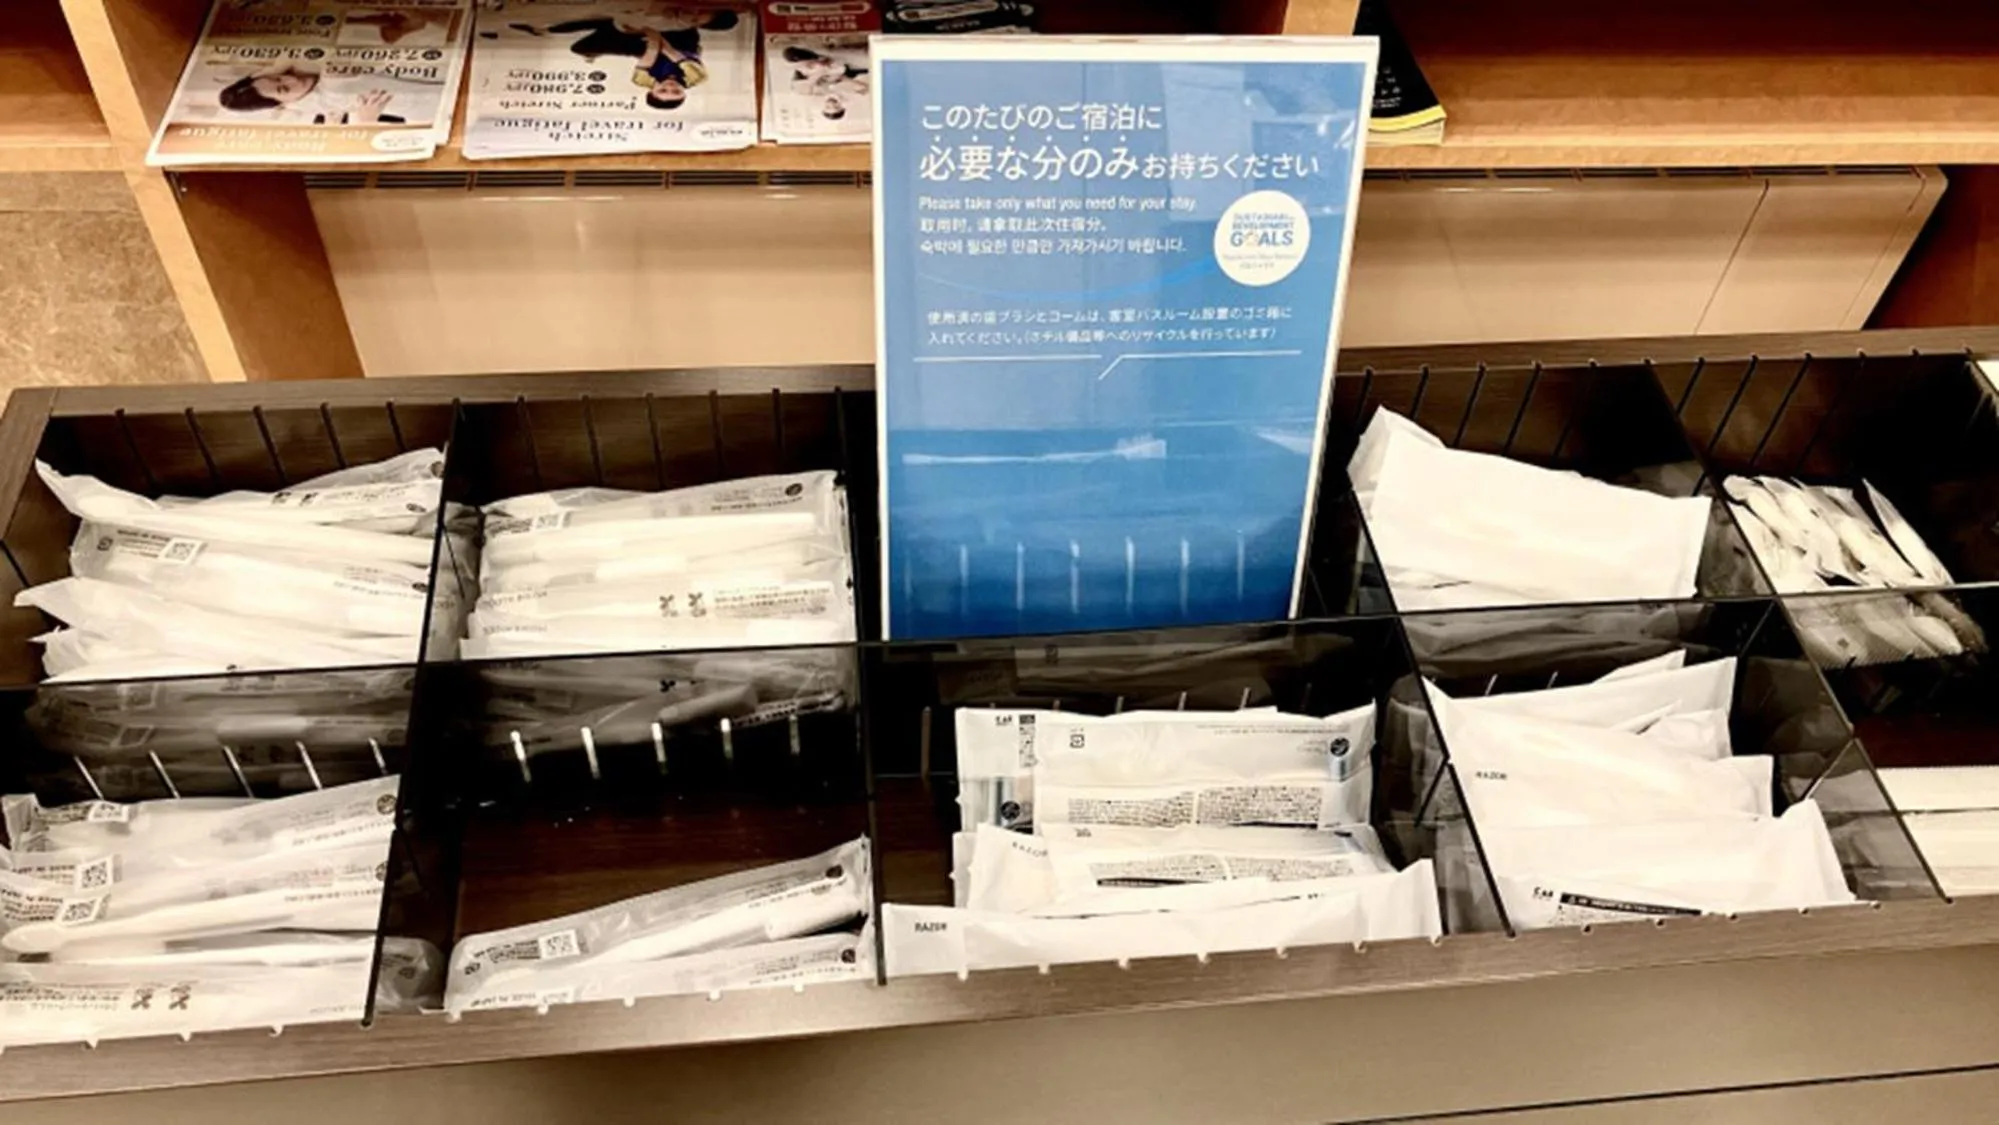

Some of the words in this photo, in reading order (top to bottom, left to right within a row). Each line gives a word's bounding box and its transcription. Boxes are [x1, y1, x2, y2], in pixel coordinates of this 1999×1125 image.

[382, 65, 440, 80] Body
[921, 103, 1162, 131] このたびのご宿泊に
[493, 118, 572, 133] fatigue
[580, 120, 645, 132] travel
[653, 121, 685, 132] for
[270, 128, 332, 141] travel
[918, 143, 1319, 183] 必要な分のみお持ちください
[919, 196, 961, 210] Please
[965, 196, 992, 210] take
[997, 196, 1022, 212] only
[1025, 196, 1056, 210] what
[1059, 198, 1082, 212] you
[1085, 196, 1117, 210] need
[1119, 196, 1137, 210] for
[1140, 198, 1167, 212] your
